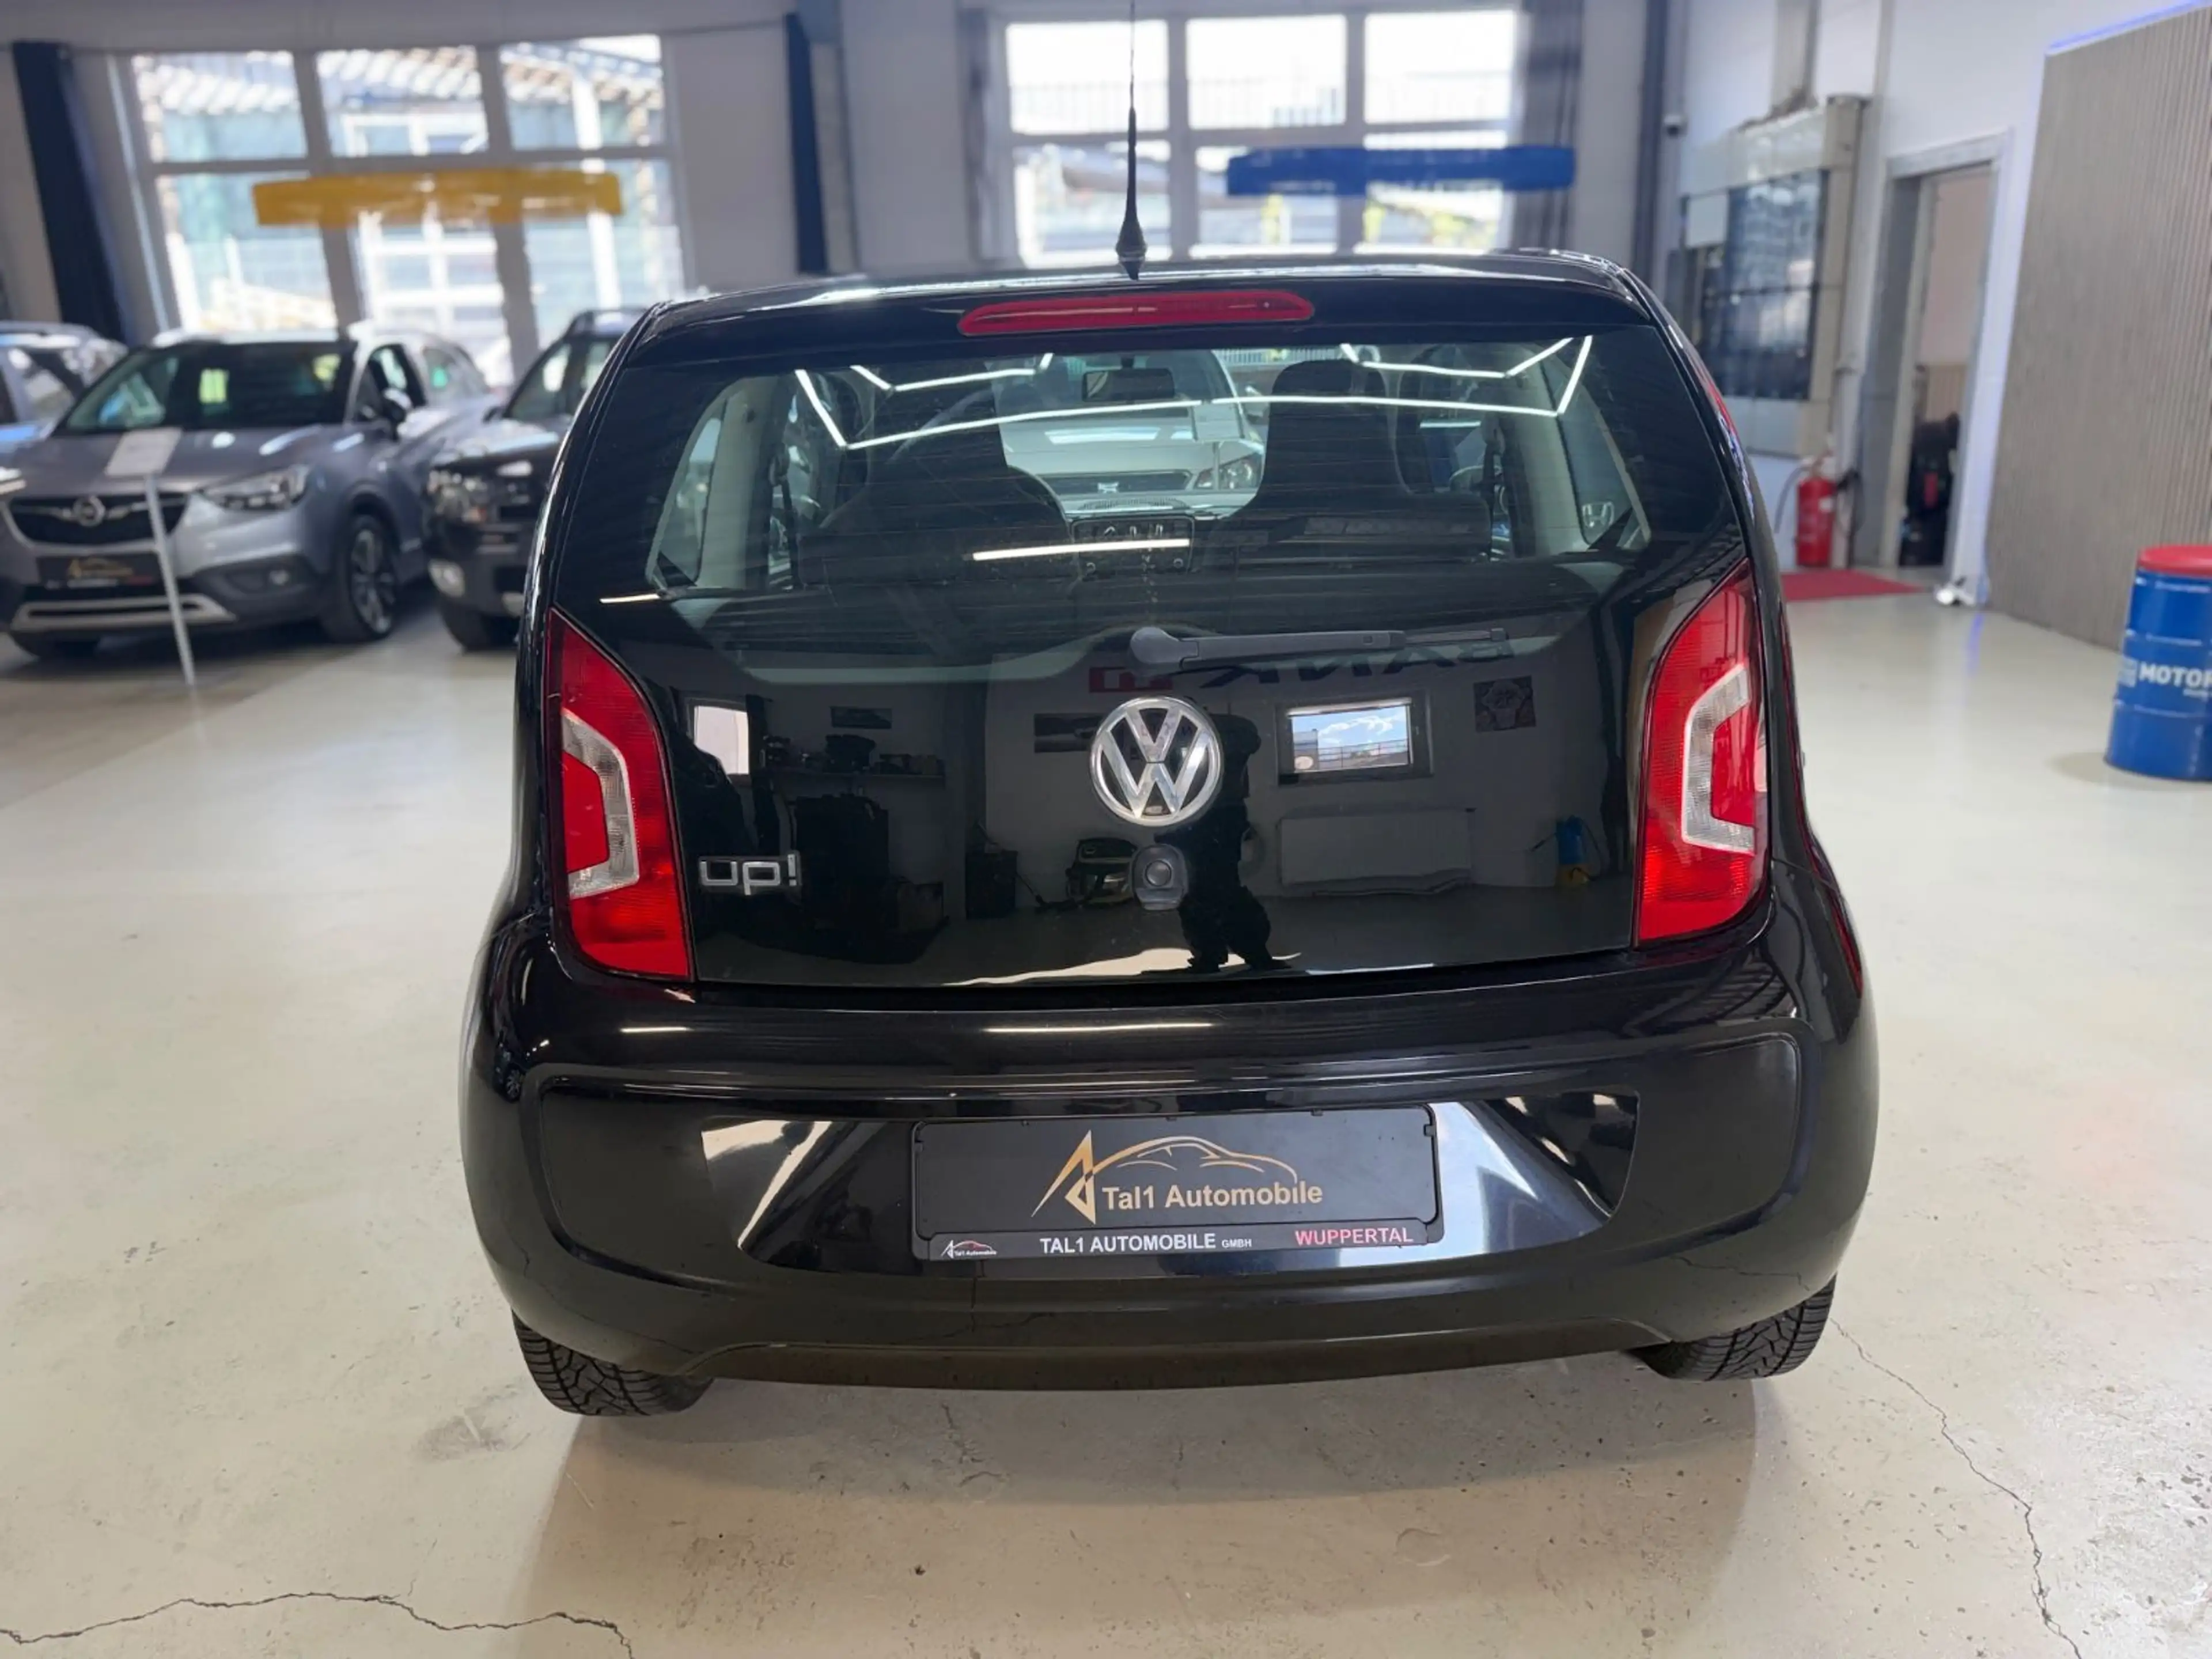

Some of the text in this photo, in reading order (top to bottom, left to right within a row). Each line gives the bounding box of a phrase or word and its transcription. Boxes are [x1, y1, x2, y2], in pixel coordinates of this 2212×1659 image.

[700, 854, 797, 895] up!
[1102, 1181, 1324, 1210] Tal1 Automobile
[1040, 1233, 1252, 1253] TAL1 AUTOMOBILE GMBH
[1294, 1227, 1414, 1245] WUPPERTAL
